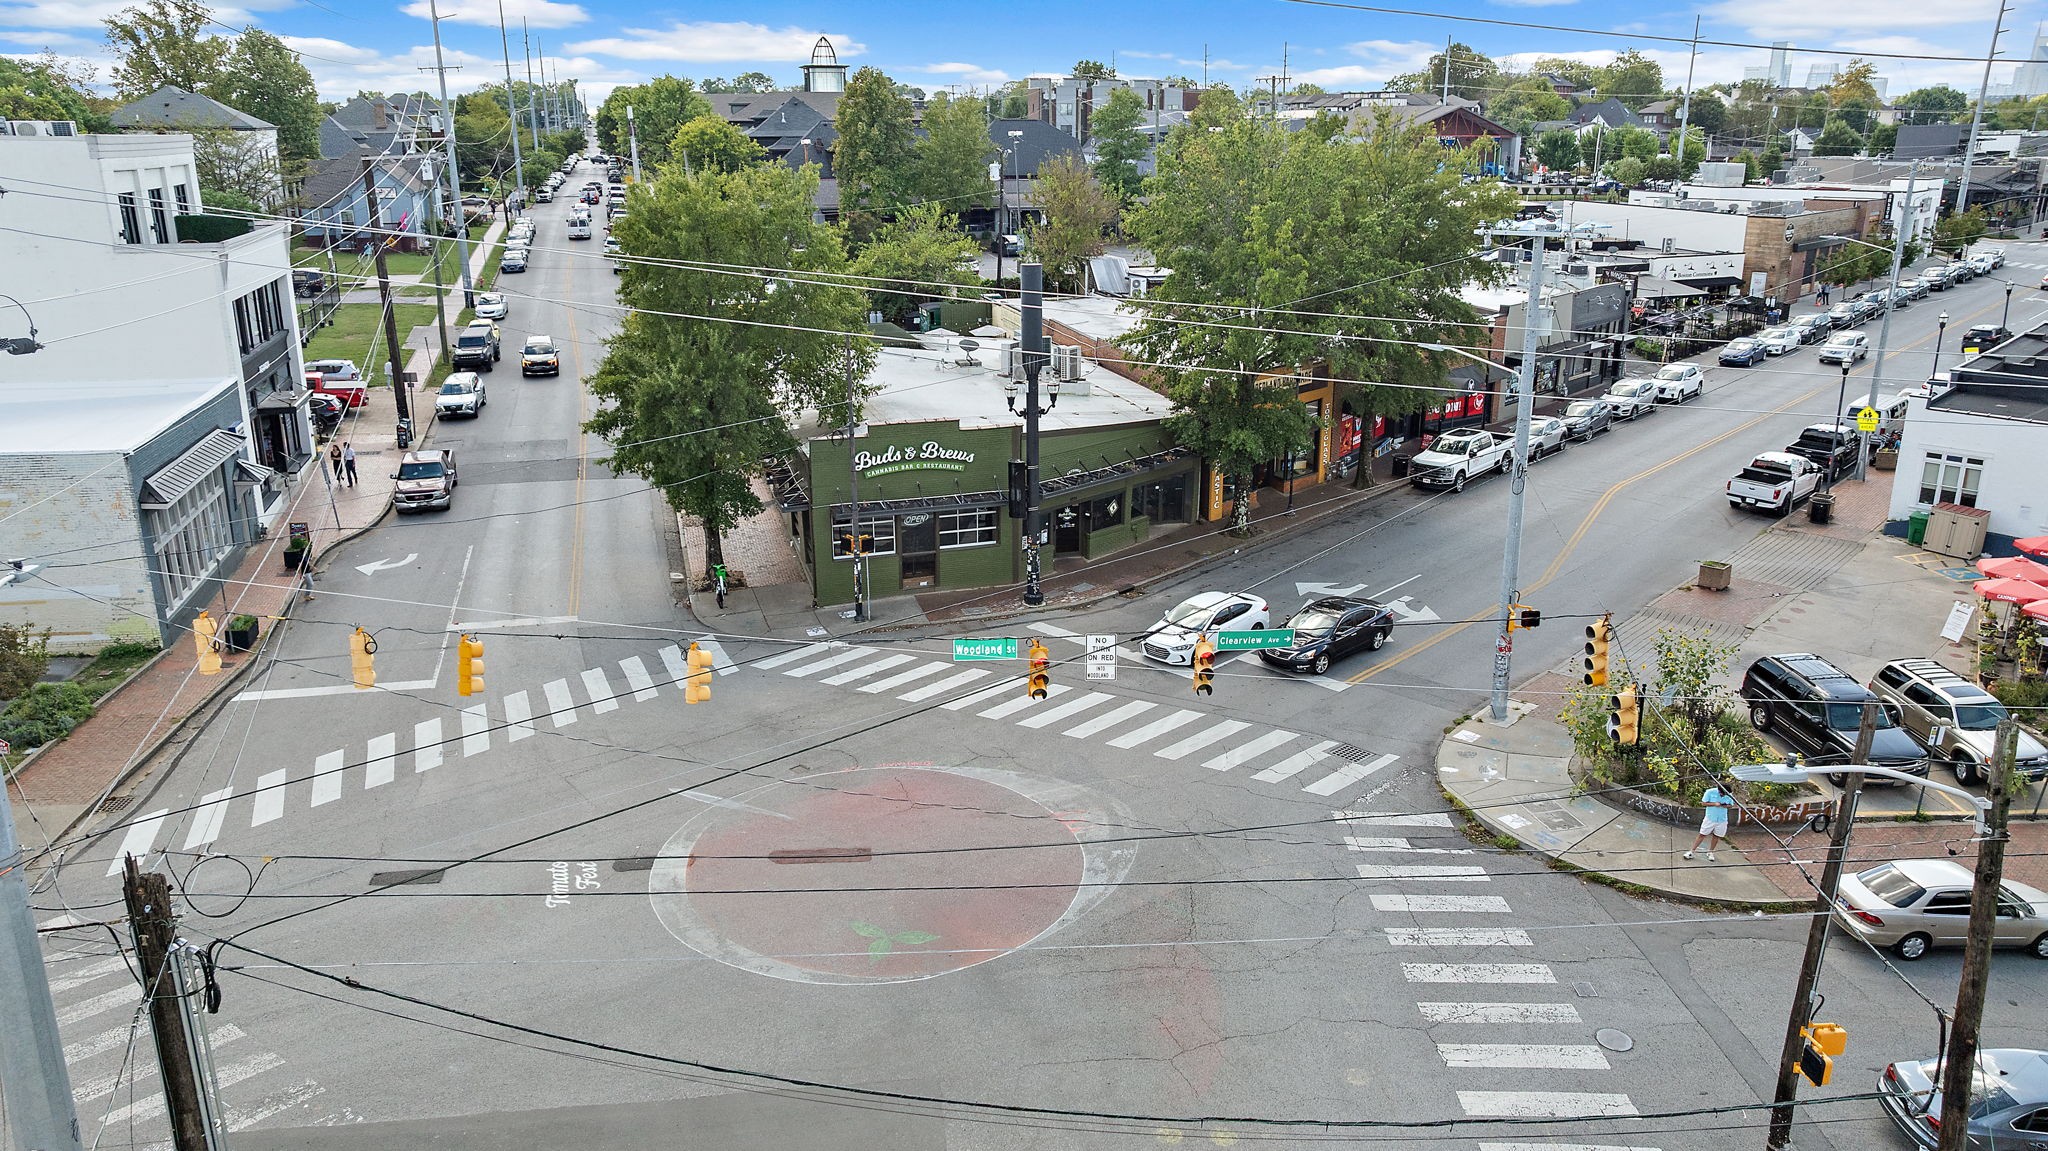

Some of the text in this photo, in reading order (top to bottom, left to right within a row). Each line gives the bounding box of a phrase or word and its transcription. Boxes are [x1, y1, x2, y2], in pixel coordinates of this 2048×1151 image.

[855, 441, 974, 471] Buds & Brews
[866, 465, 899, 476] CANNABIS
[923, 463, 963, 471] RESTAURANT
[906, 515, 926, 524] OPEN
[1220, 636, 1262, 645] Clearview
[956, 644, 1016, 656] Woodland St
[1092, 645, 1111, 653] TURN
[575, 861, 601, 890] Fest
[545, 861, 570, 908] Tomato
